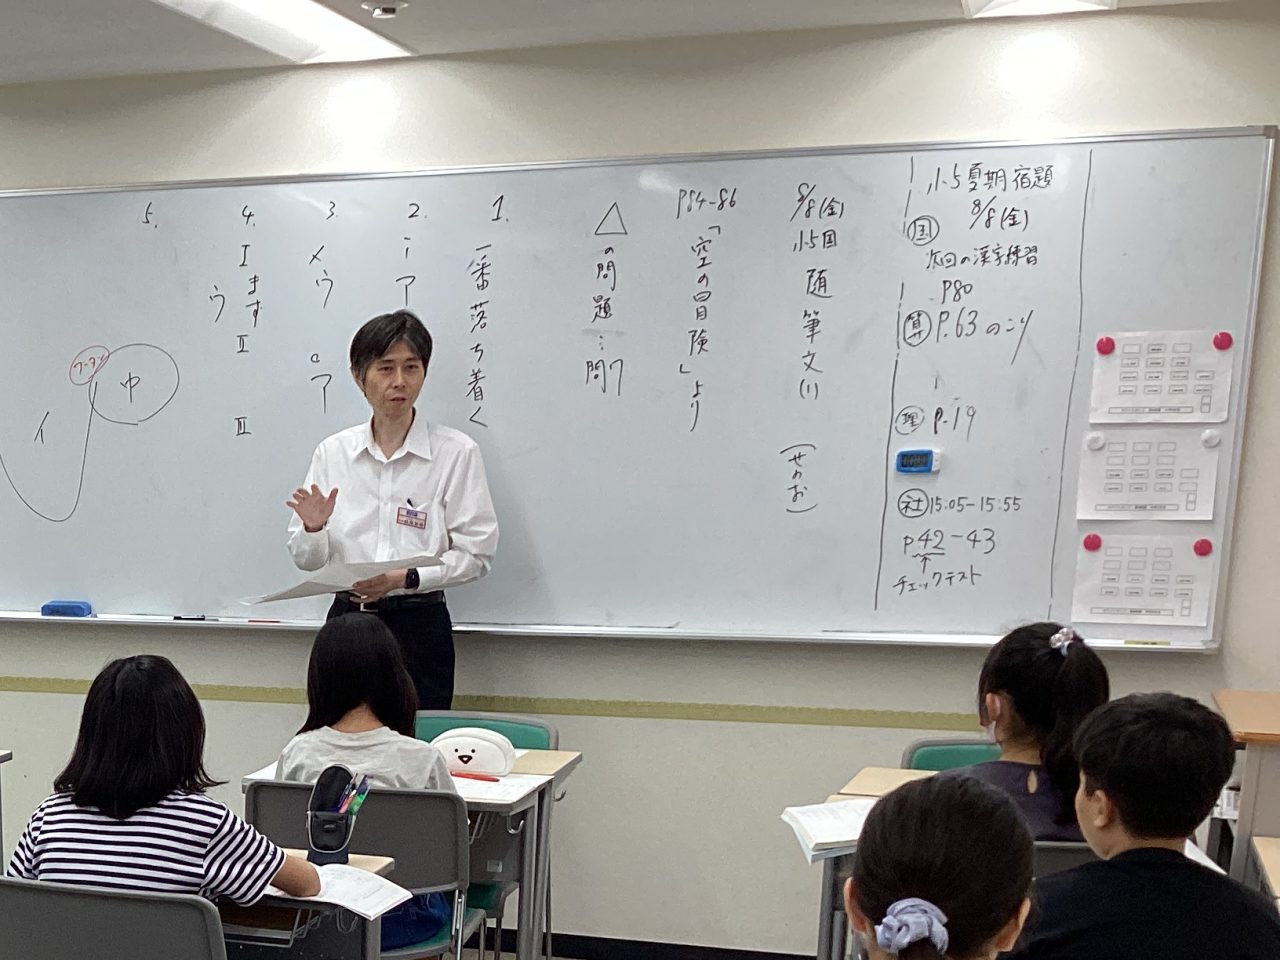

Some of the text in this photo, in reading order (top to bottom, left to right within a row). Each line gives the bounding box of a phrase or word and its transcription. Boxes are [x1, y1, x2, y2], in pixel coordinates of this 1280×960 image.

[941, 280, 974, 305] P80
[465, 244, 493, 428] 一番落ち着く
[310, 374, 333, 414] ア
[899, 491, 927, 516] 社
[892, 564, 982, 595] チェックテスト
